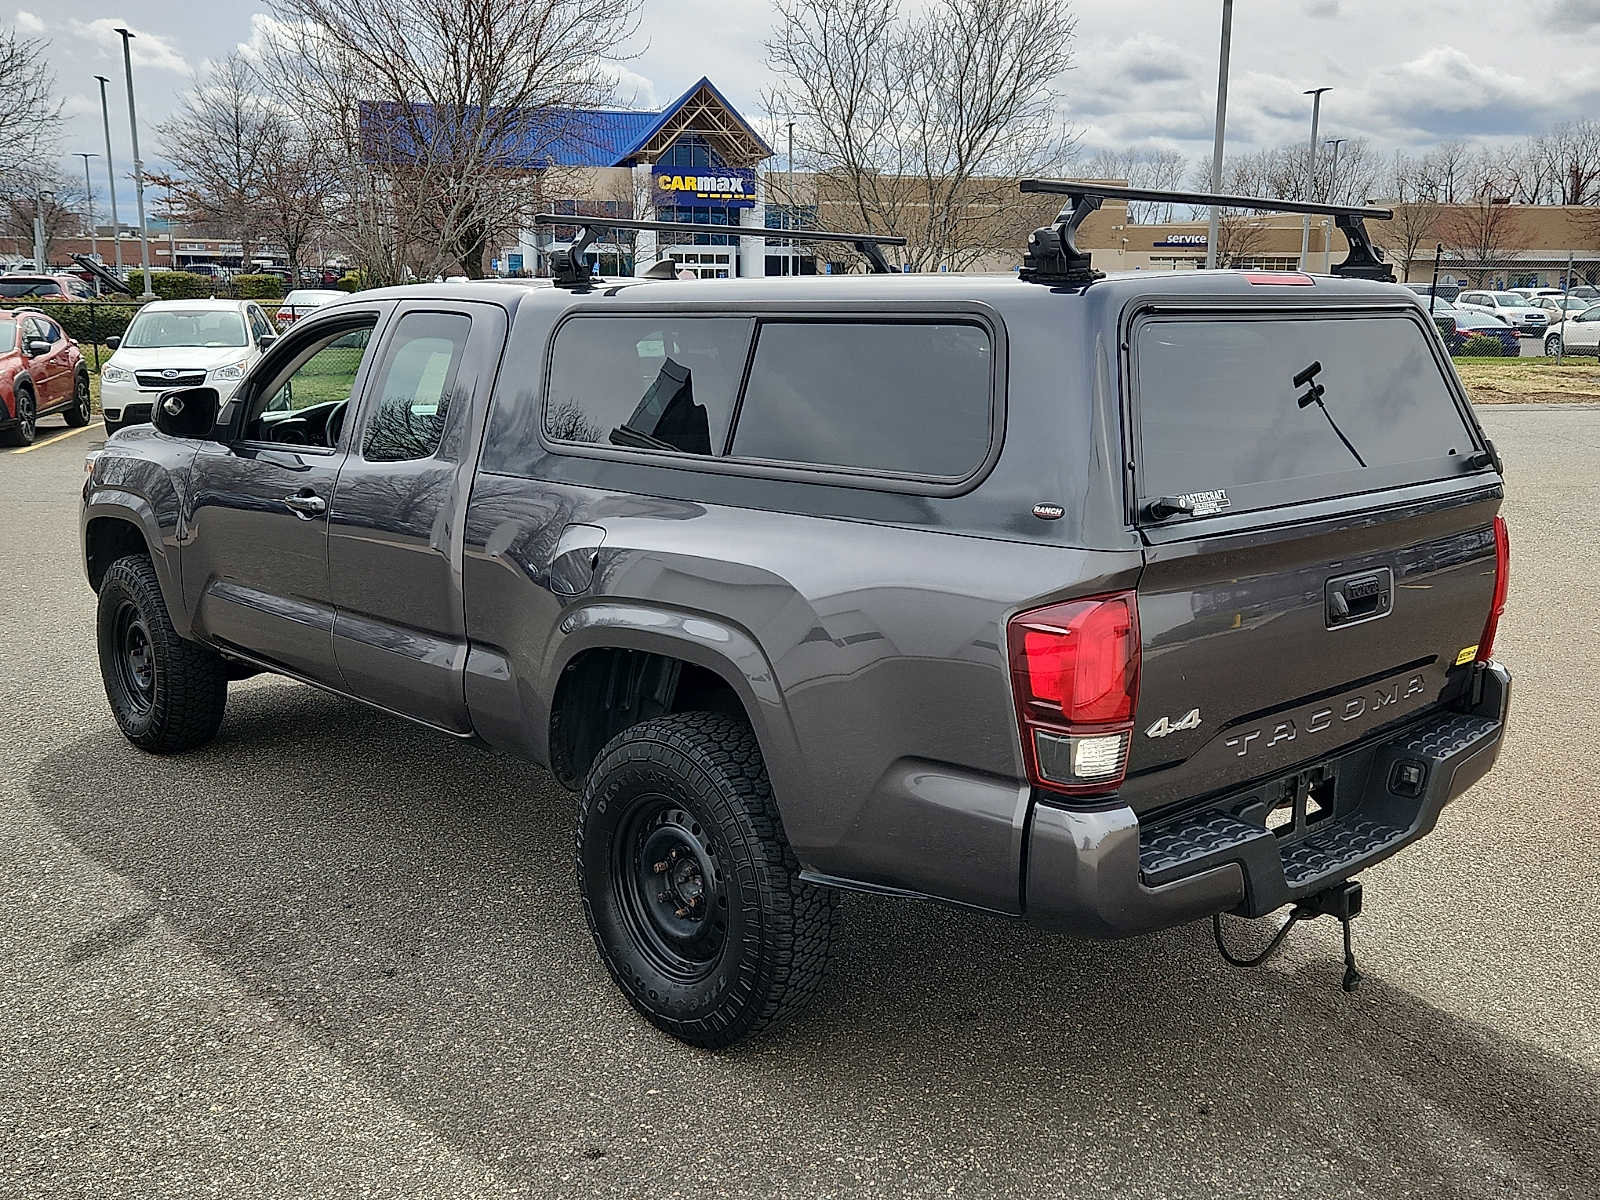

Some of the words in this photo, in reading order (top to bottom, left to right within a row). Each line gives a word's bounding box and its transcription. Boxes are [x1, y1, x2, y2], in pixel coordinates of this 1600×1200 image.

[1166, 233, 1207, 244] service
[1033, 505, 1063, 515] RANCH
[1225, 673, 1425, 757] TACOMA
